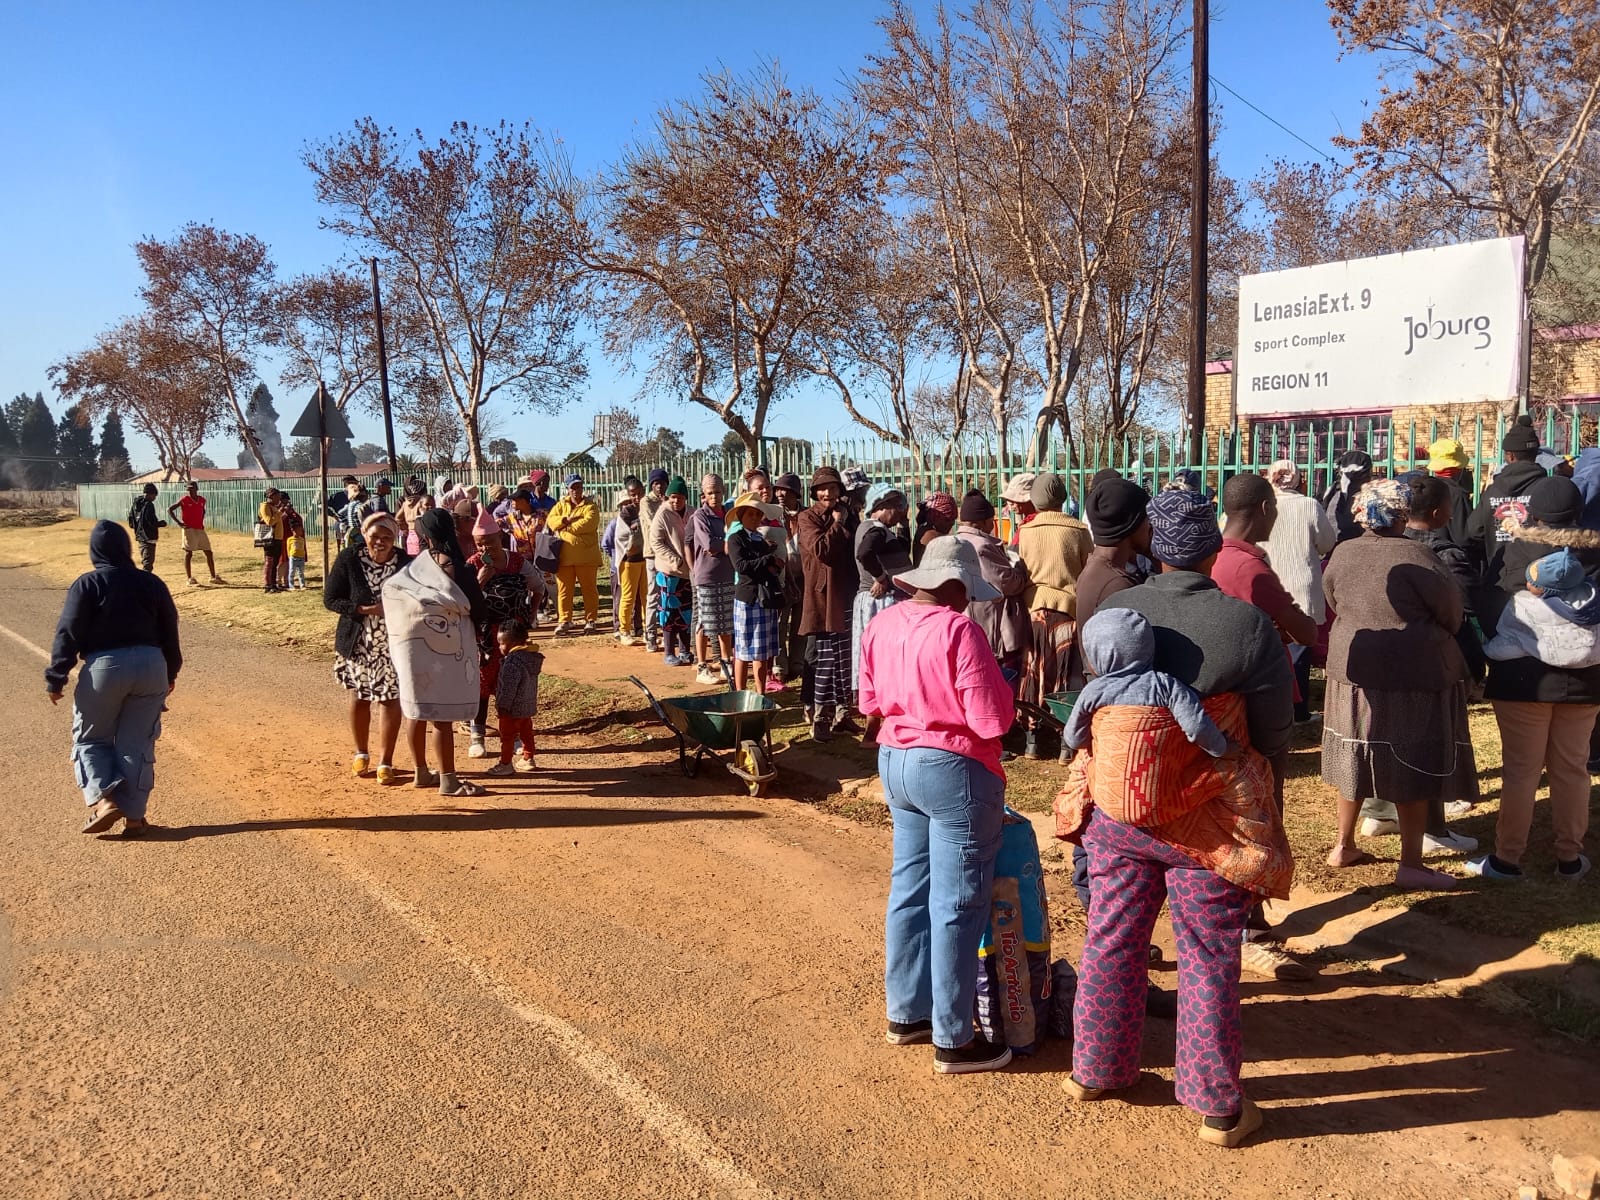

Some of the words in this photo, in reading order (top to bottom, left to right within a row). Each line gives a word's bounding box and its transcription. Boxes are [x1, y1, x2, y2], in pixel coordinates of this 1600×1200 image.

[1254, 292, 1355, 322] LenasiaExt.
[1361, 288, 1371, 309] 9
[1404, 296, 1491, 355] Joburg
[1254, 337, 1288, 352] Sport
[1292, 331, 1345, 347] Complex
[1252, 372, 1309, 391] REGION
[1315, 372, 1328, 387] 11
[1001, 930, 1018, 957] Tio
